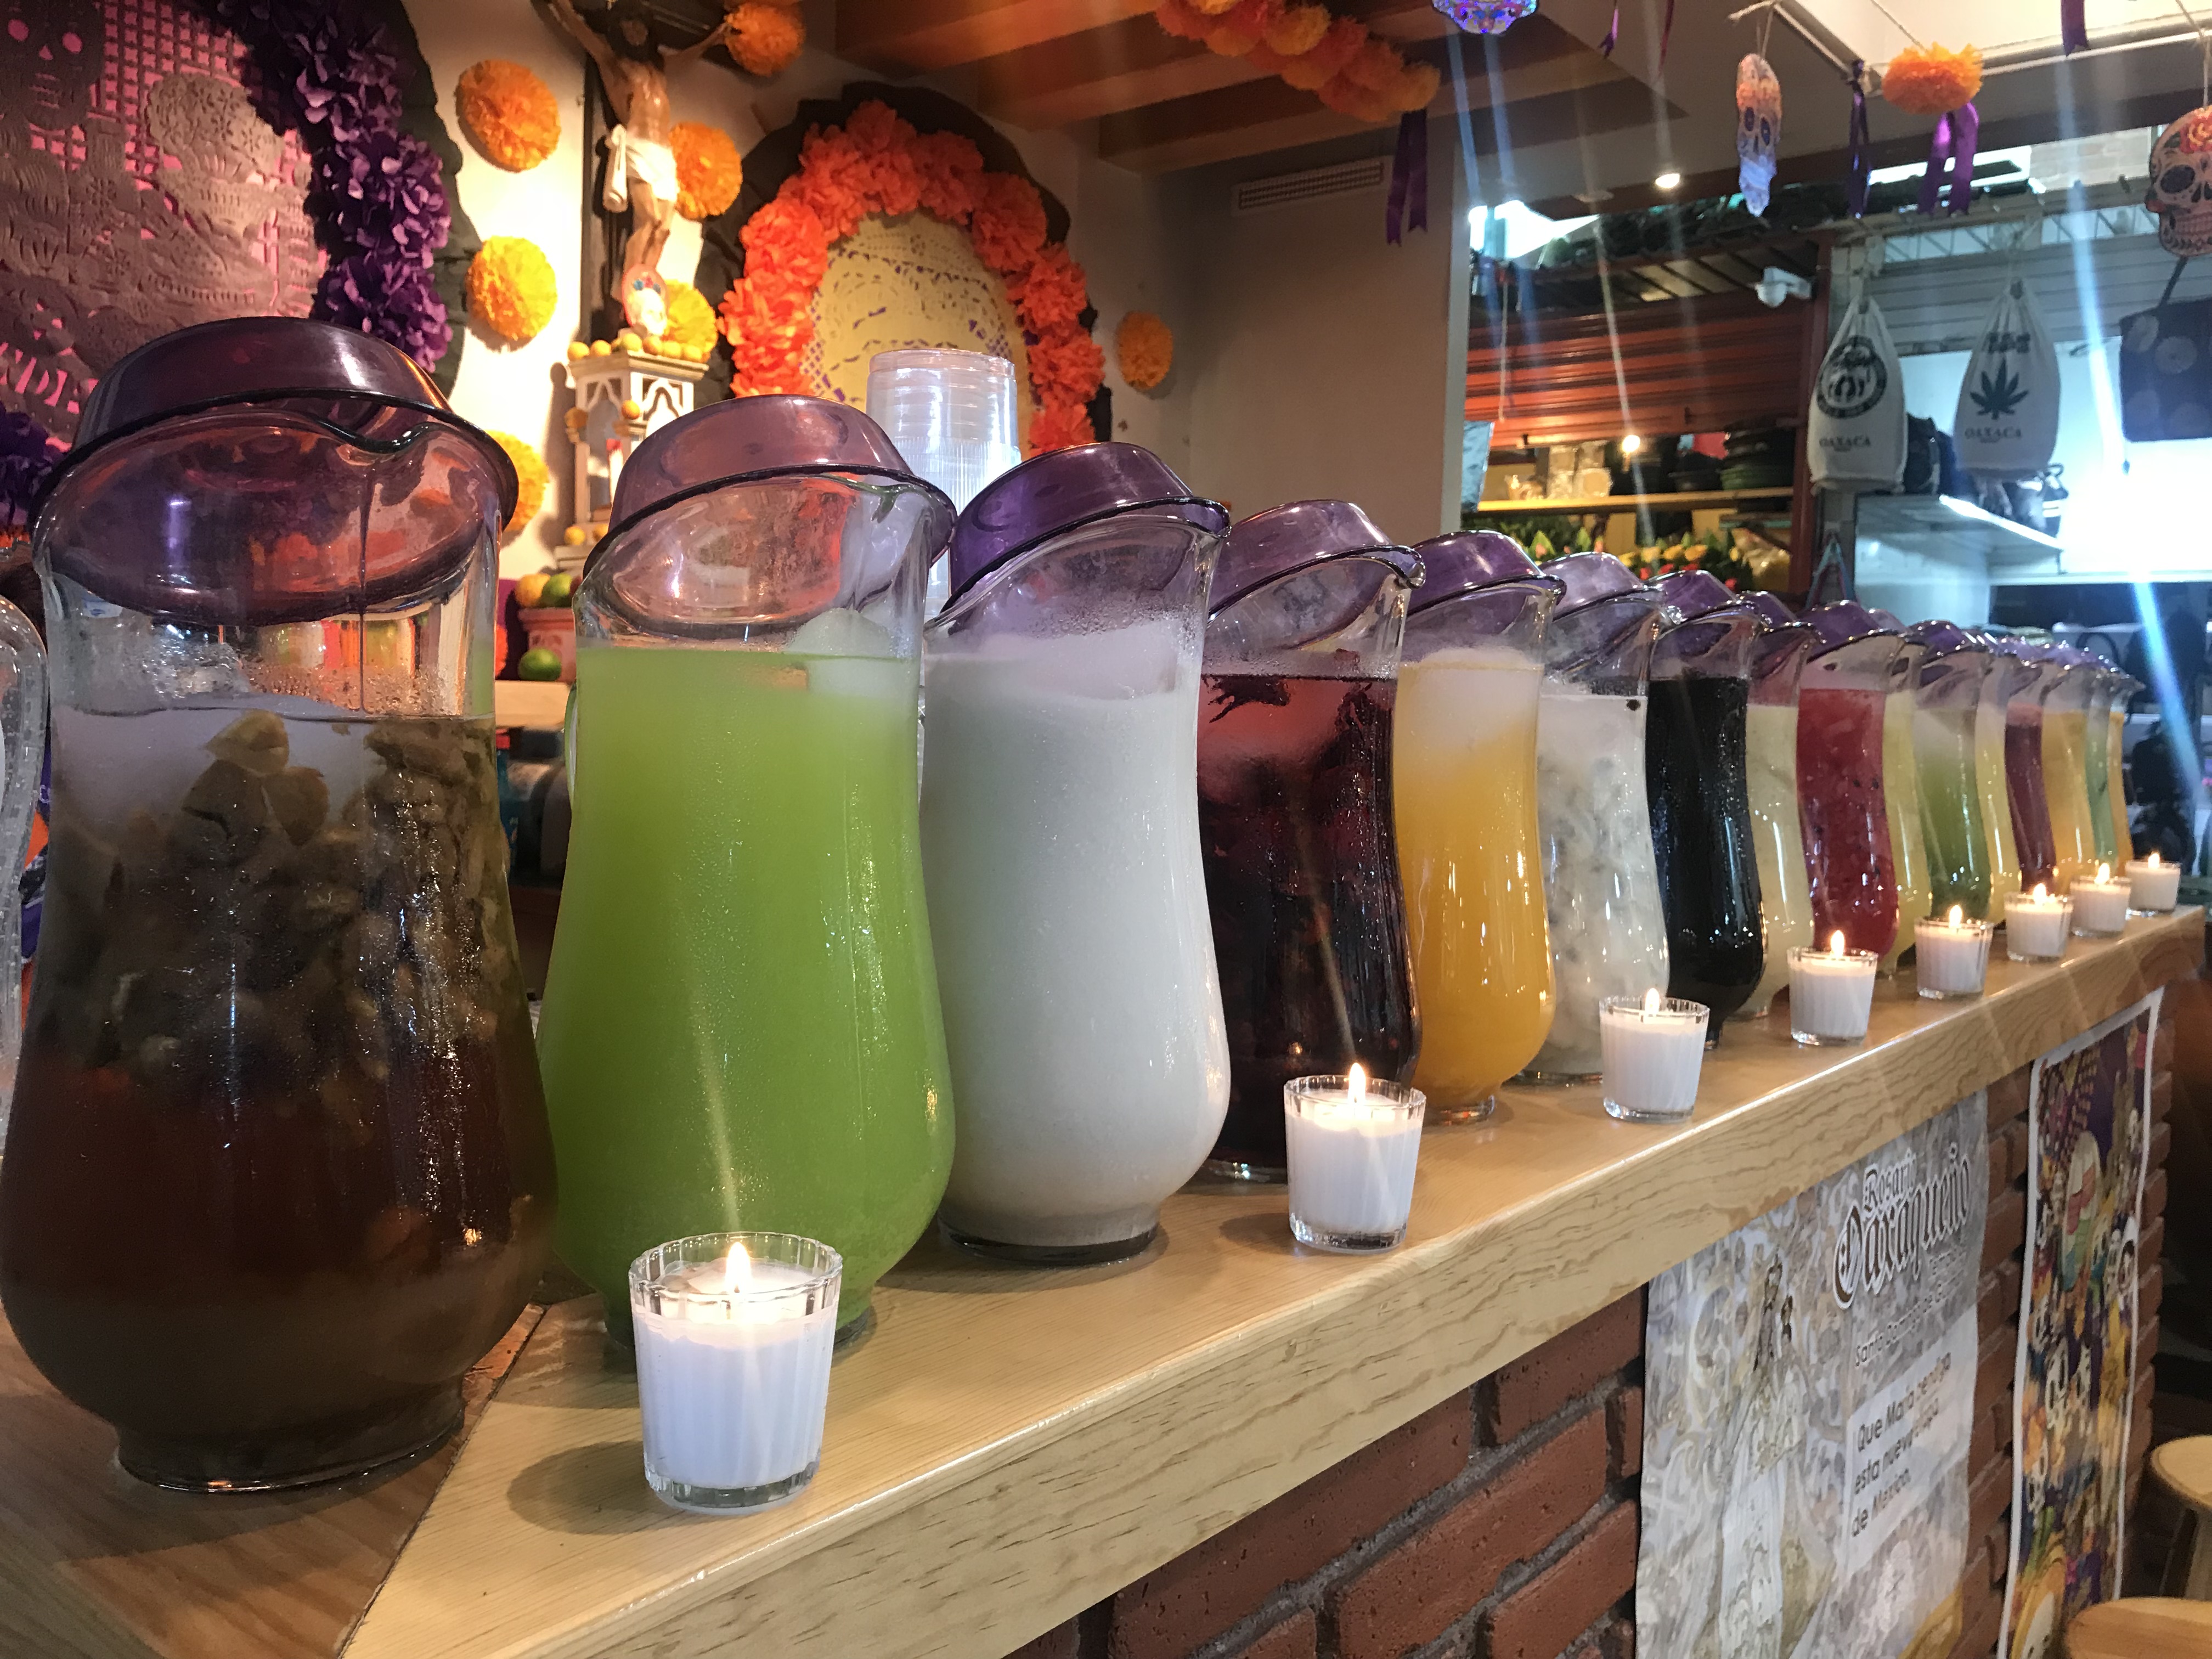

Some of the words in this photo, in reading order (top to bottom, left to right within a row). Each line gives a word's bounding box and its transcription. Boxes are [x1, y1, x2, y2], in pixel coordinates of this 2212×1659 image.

[1858, 1419, 1882, 1453] Que
[1855, 1458, 1880, 1495] esta
[1852, 1508, 1869, 1537] de
